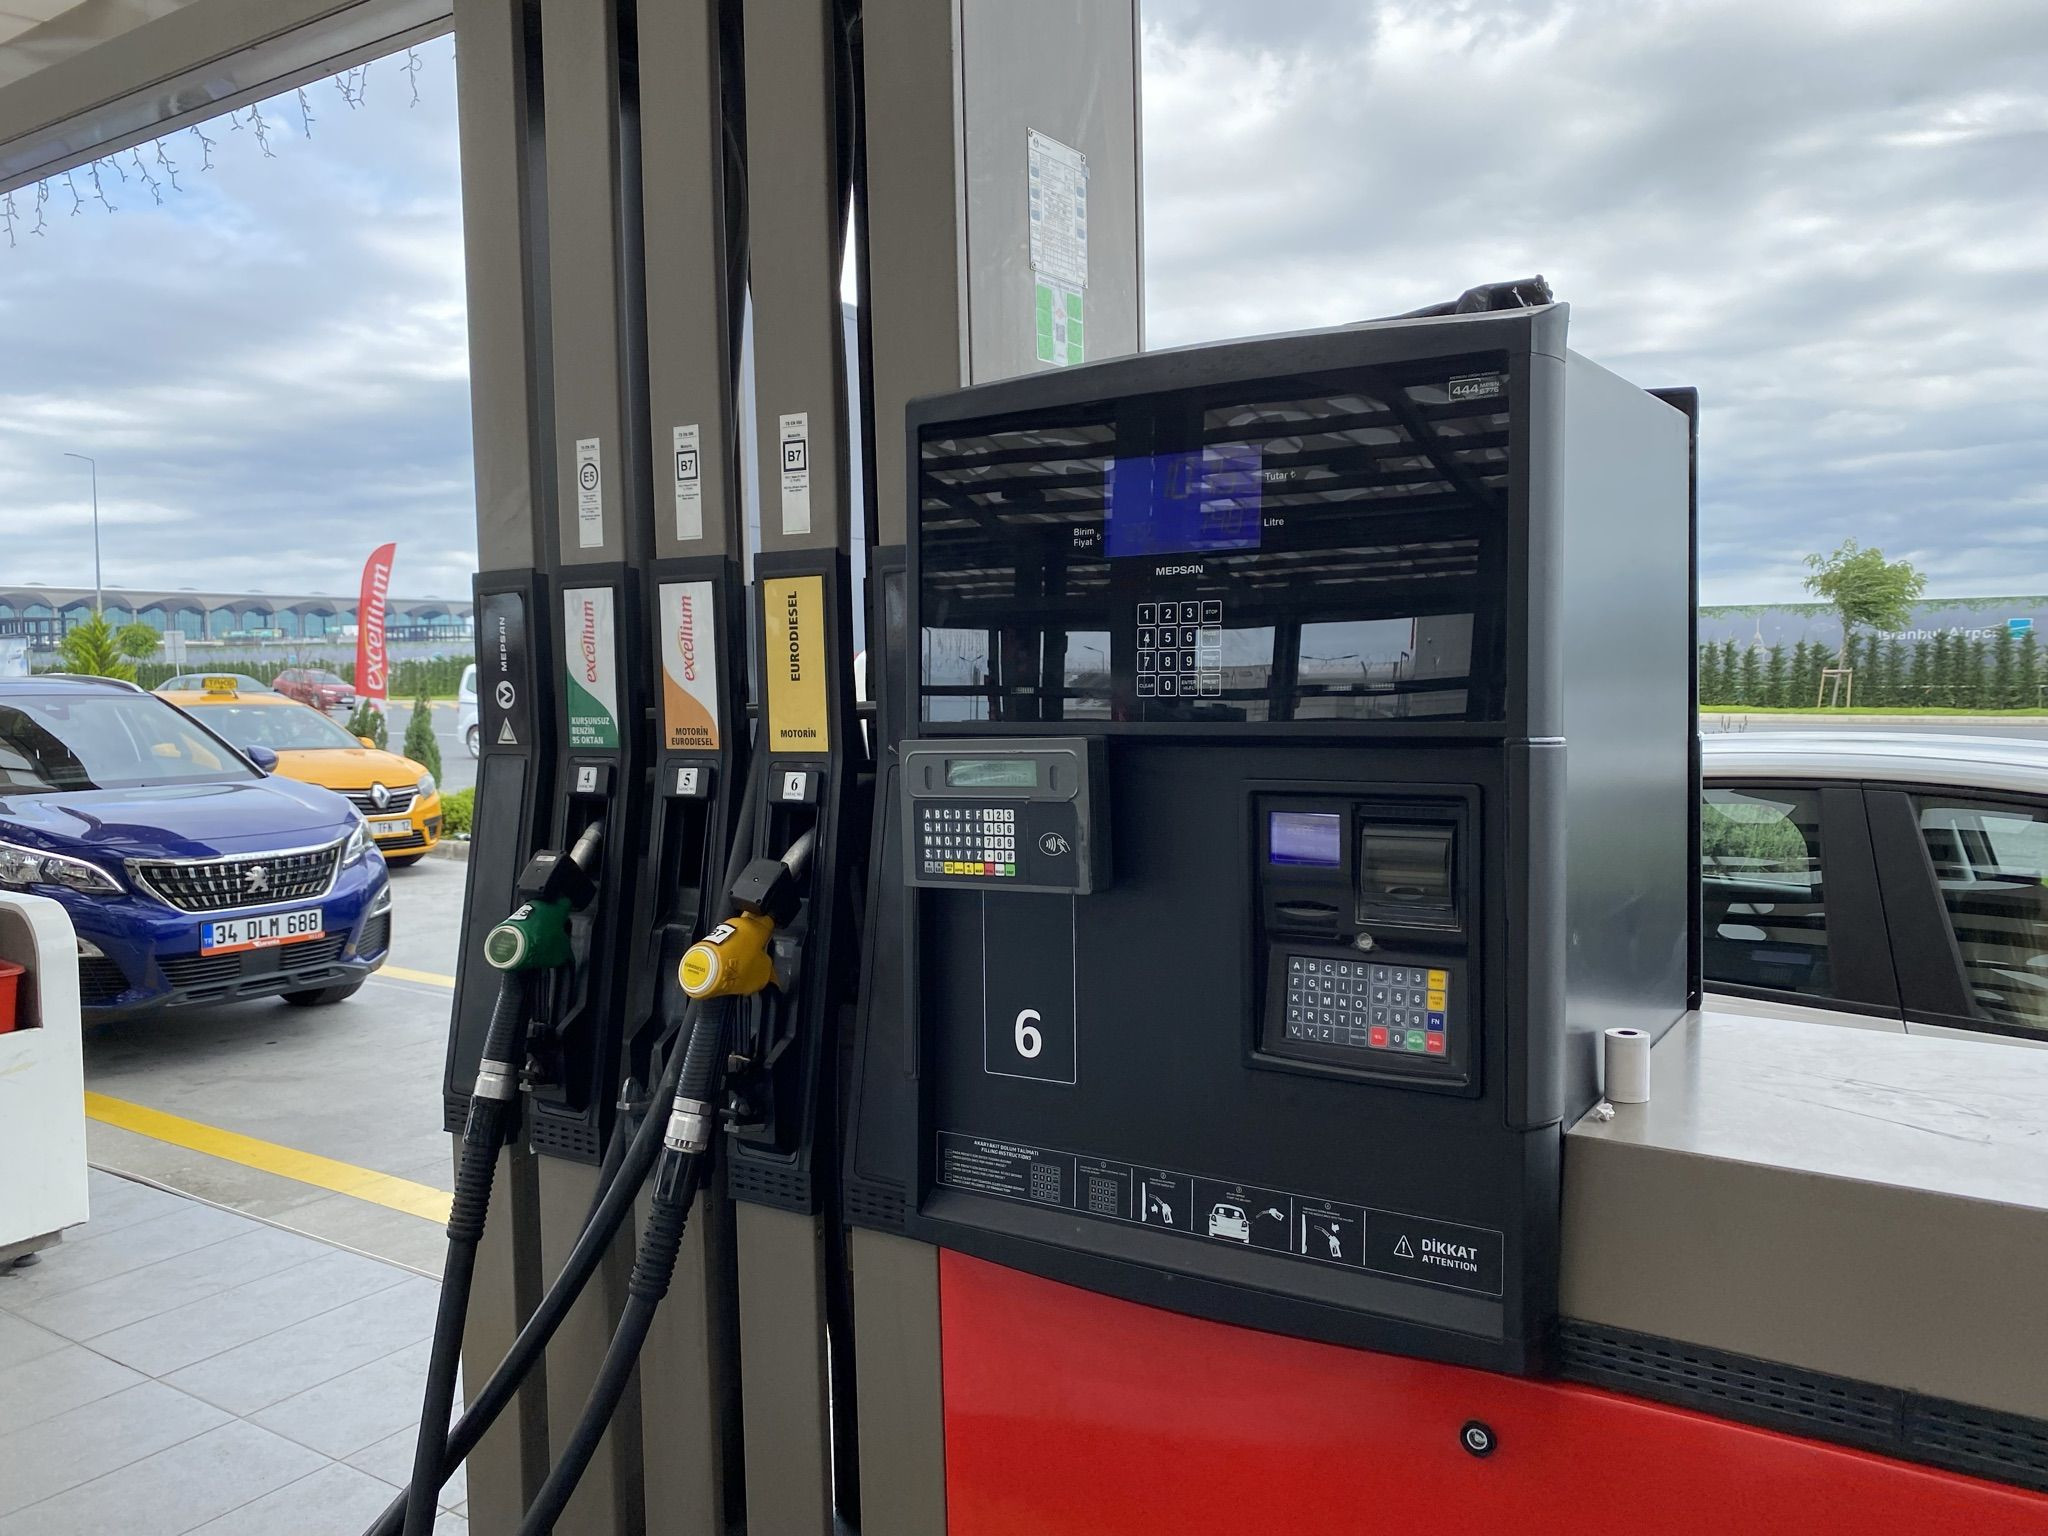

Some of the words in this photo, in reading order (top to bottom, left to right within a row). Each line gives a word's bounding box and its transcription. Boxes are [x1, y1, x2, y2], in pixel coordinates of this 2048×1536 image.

[1452, 384, 1479, 395] 444
[788, 450, 801, 462] B7
[681, 460, 693, 471] B7
[583, 471, 594, 482] E5
[1265, 471, 1287, 481] Tutar
[1264, 517, 1284, 527] Litre
[1073, 527, 1094, 536] Birim
[1073, 538, 1093, 548] Fiyat
[1156, 565, 1204, 576] MEPSAN
[1144, 610, 1149, 619] 1
[1165, 609, 1171, 619] 2
[1186, 608, 1193, 618] 3
[365, 563, 389, 691] excellium
[581, 599, 595, 683] excellium
[678, 595, 694, 682] excellium
[789, 591, 801, 683] EURODIESEL
[1144, 633, 1150, 643] 4
[1165, 633, 1171, 643] 5
[1186, 632, 1192, 642] 6
[1144, 657, 1150, 666] 7
[1164, 656, 1171, 666] 8
[1186, 656, 1192, 666] 9
[1164, 680, 1171, 690] 0
[571, 716, 610, 727] KURŞUNSUZ
[571, 725, 595, 735] BENZİN
[675, 725, 708, 736] MOTORİN
[780, 727, 816, 738] MOTORİN
[572, 736, 580, 744] 95
[581, 736, 604, 745] OKTAN
[671, 737, 713, 746] EURODIESEL
[584, 770, 591, 784] 4
[683, 773, 691, 786] 5
[791, 777, 798, 791] 6
[925, 810, 930, 819] A
[935, 810, 940, 819] B
[943, 810, 949, 819] C
[955, 810, 960, 819] D
[965, 810, 970, 819] E
[976, 811, 980, 819] F
[987, 810, 991, 819] 1
[996, 810, 1001, 819] 2
[1007, 811, 1012, 819] 3
[924, 823, 930, 832] G
[935, 823, 941, 832] H
[956, 824, 960, 832] J
[966, 824, 970, 832] K
[976, 824, 980, 833] L
[986, 824, 991, 832] 4
[997, 824, 1001, 832] 5
[1007, 824, 1012, 833] 6
[925, 836, 932, 845] M
[935, 836, 941, 845] N
[945, 837, 949, 845] O
[956, 837, 961, 845] P
[966, 837, 971, 846] Q
[976, 838, 981, 846] R
[987, 838, 991, 846] 7
[997, 838, 1001, 846] 8
[1007, 838, 1012, 847] 9
[925, 850, 930, 858] S
[936, 850, 941, 858] T
[945, 850, 950, 858] U
[956, 851, 962, 859] V
[966, 851, 971, 859] Y
[977, 852, 981, 860] Z
[997, 852, 1002, 860] 0
[1007, 852, 1013, 860] #
[215, 924, 237, 944] 34
[247, 918, 279, 940] DLM
[288, 912, 317, 934] 688
[1293, 962, 1300, 970] A
[1309, 963, 1315, 971] B
[1325, 964, 1332, 973] C
[1341, 966, 1347, 974] D
[1379, 971, 1383, 980] 1
[1397, 973, 1402, 981] 2
[1415, 974, 1421, 982] 3
[1309, 980, 1315, 988] G
[1324, 981, 1331, 989] H
[1357, 984, 1363, 992] J
[1292, 994, 1299, 1002] K
[1324, 997, 1331, 1005] M
[1340, 999, 1346, 1007] N
[1356, 1000, 1363, 1008] O
[1377, 992, 1383, 1000] 4
[1395, 993, 1401, 1001] 5
[1414, 995, 1420, 1003] 6
[1292, 1010, 1298, 1018] P
[1307, 1012, 1314, 1020] R
[1323, 1013, 1330, 1022] S
[1339, 1015, 1345, 1023] T
[1355, 1016, 1362, 1025] U
[1395, 1014, 1401, 1022] 8
[1414, 1015, 1420, 1024] 9
[1014, 1008, 1042, 1058] 6
[1307, 1028, 1313, 1036] Y
[1394, 1034, 1400, 1042] 0
[1422, 1237, 1477, 1260] DİKKAT
[1422, 1254, 1478, 1272] ATTENTION
